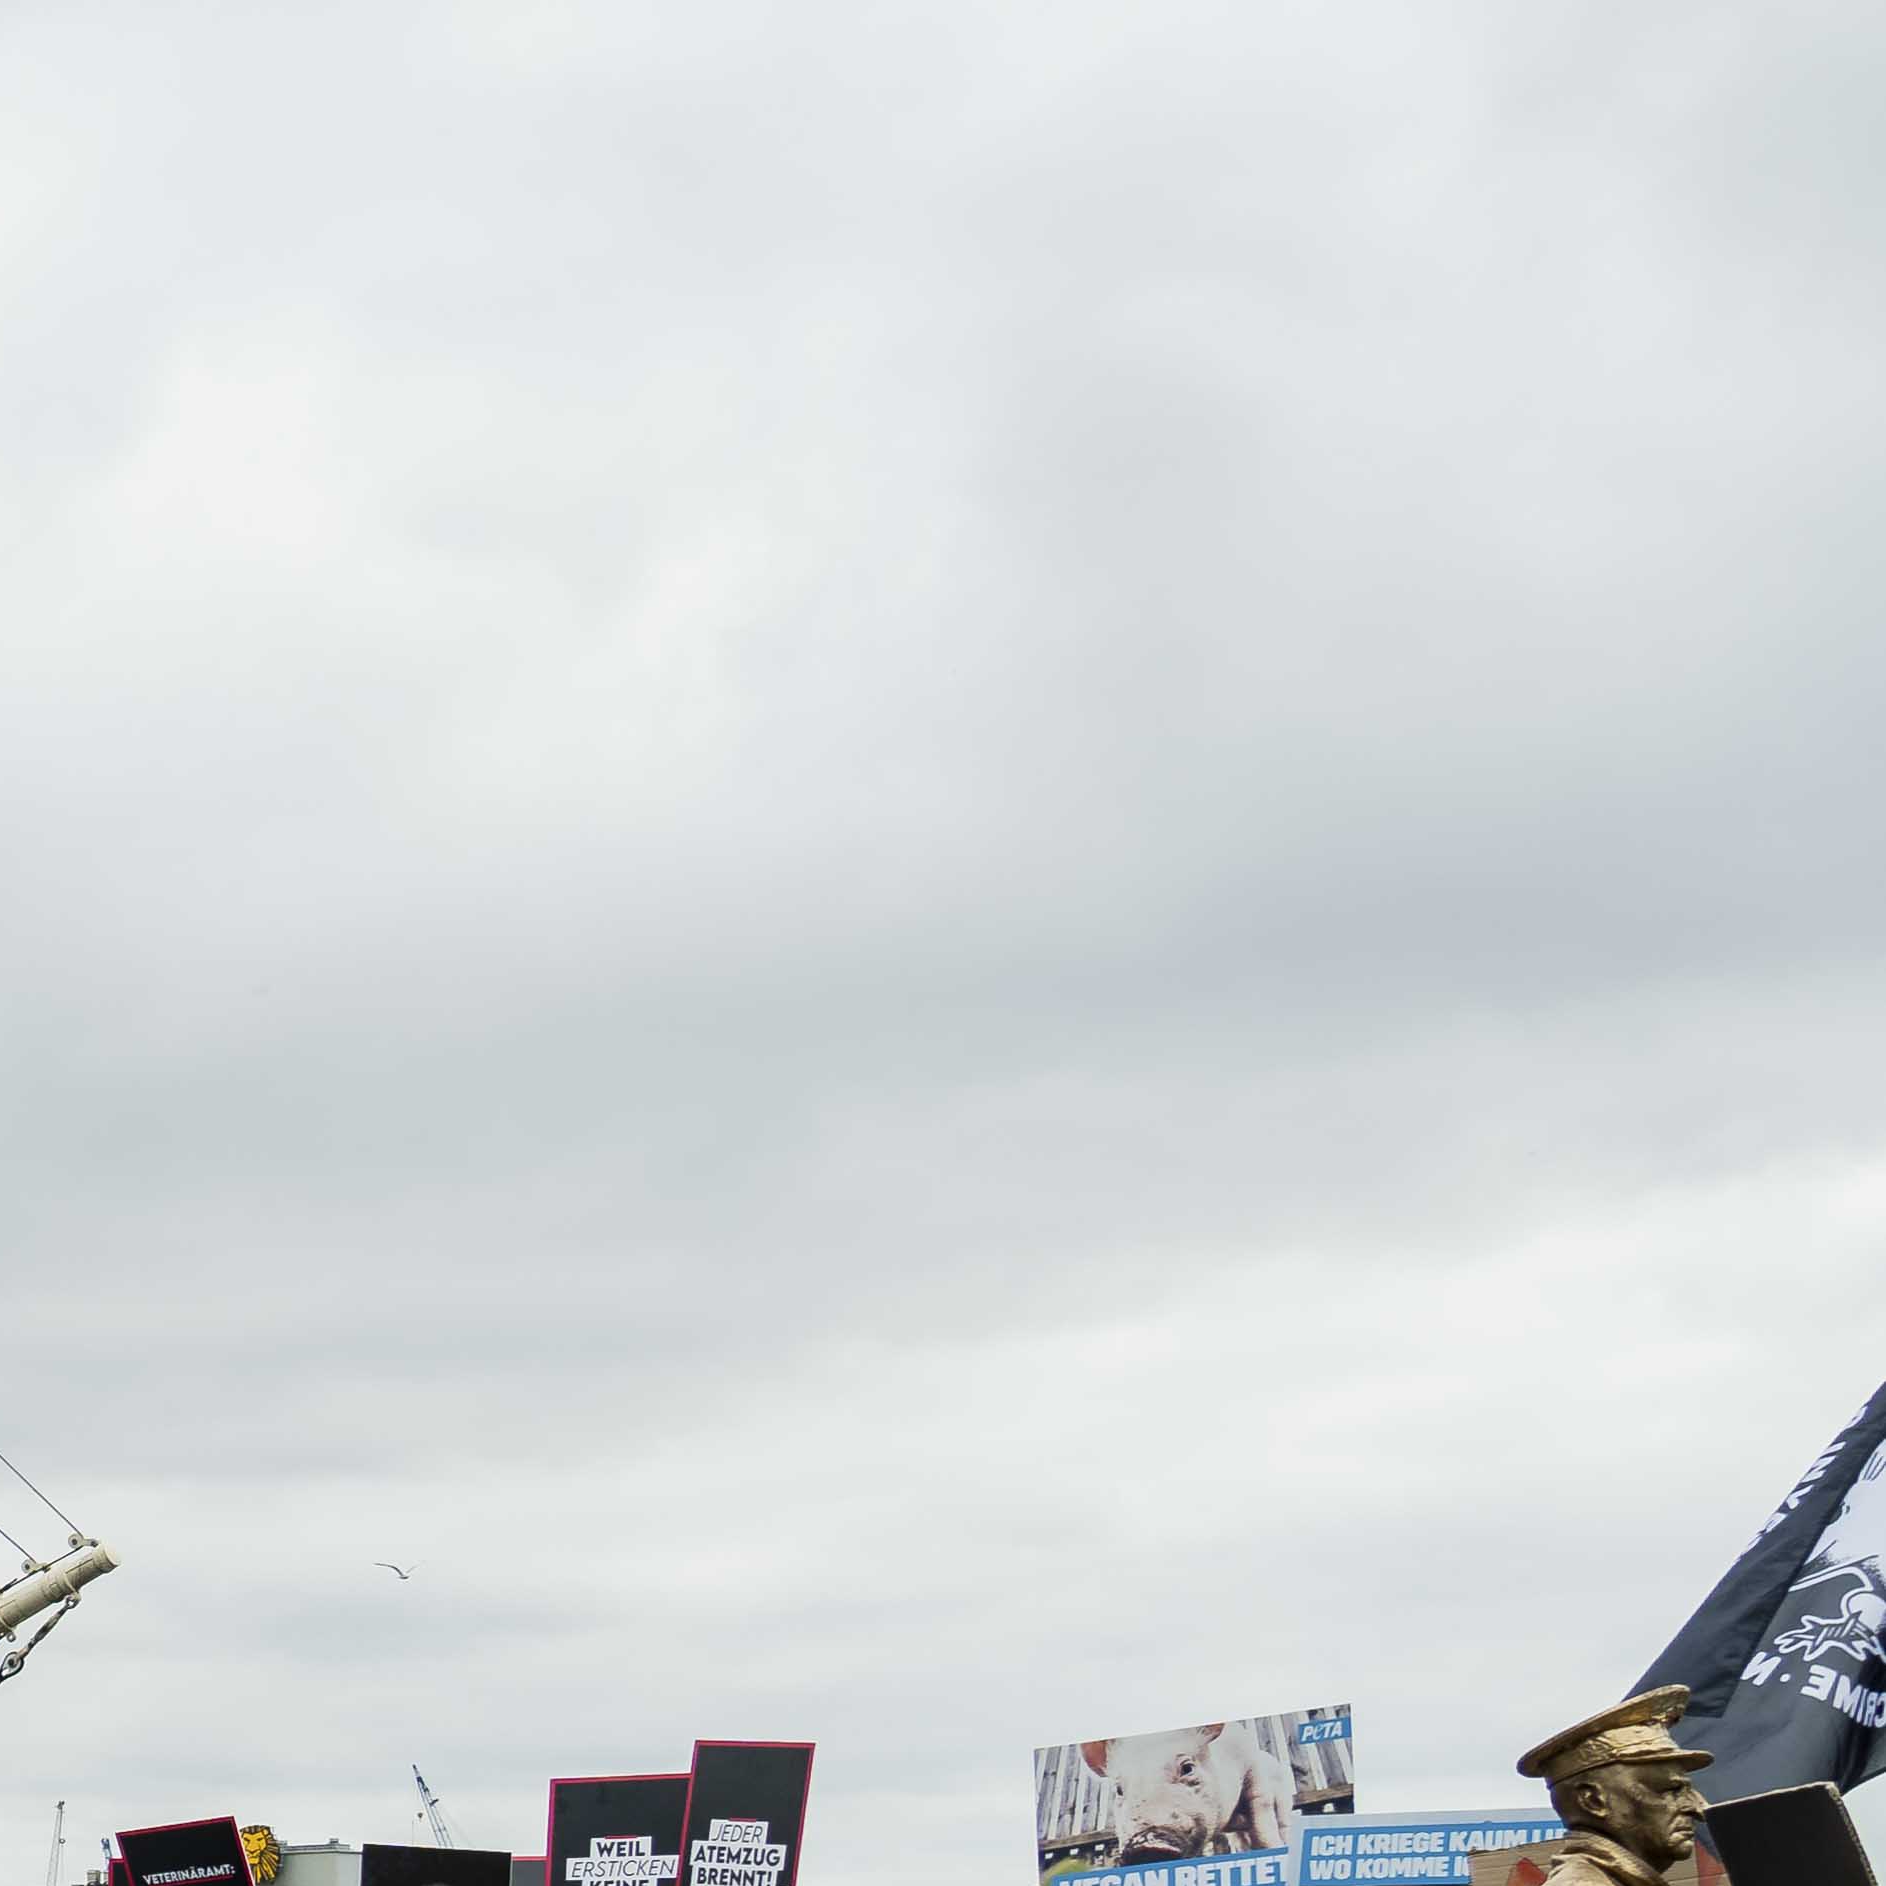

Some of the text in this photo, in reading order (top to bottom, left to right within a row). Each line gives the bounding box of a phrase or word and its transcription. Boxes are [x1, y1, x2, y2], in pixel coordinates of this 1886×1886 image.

[711, 1824, 763, 1843] JEDER
[596, 1841, 645, 1857] WEIL
[1310, 1835, 1353, 1857] ICH
[1356, 1832, 1445, 1856] KRIEGE
[694, 1845, 781, 1866] ATEMZUG
[143, 1864, 235, 1886] VETERINÄRAMT:
[572, 1859, 675, 1878] ERSTICKEN
[1309, 1856, 1450, 1880] WO KOMME
